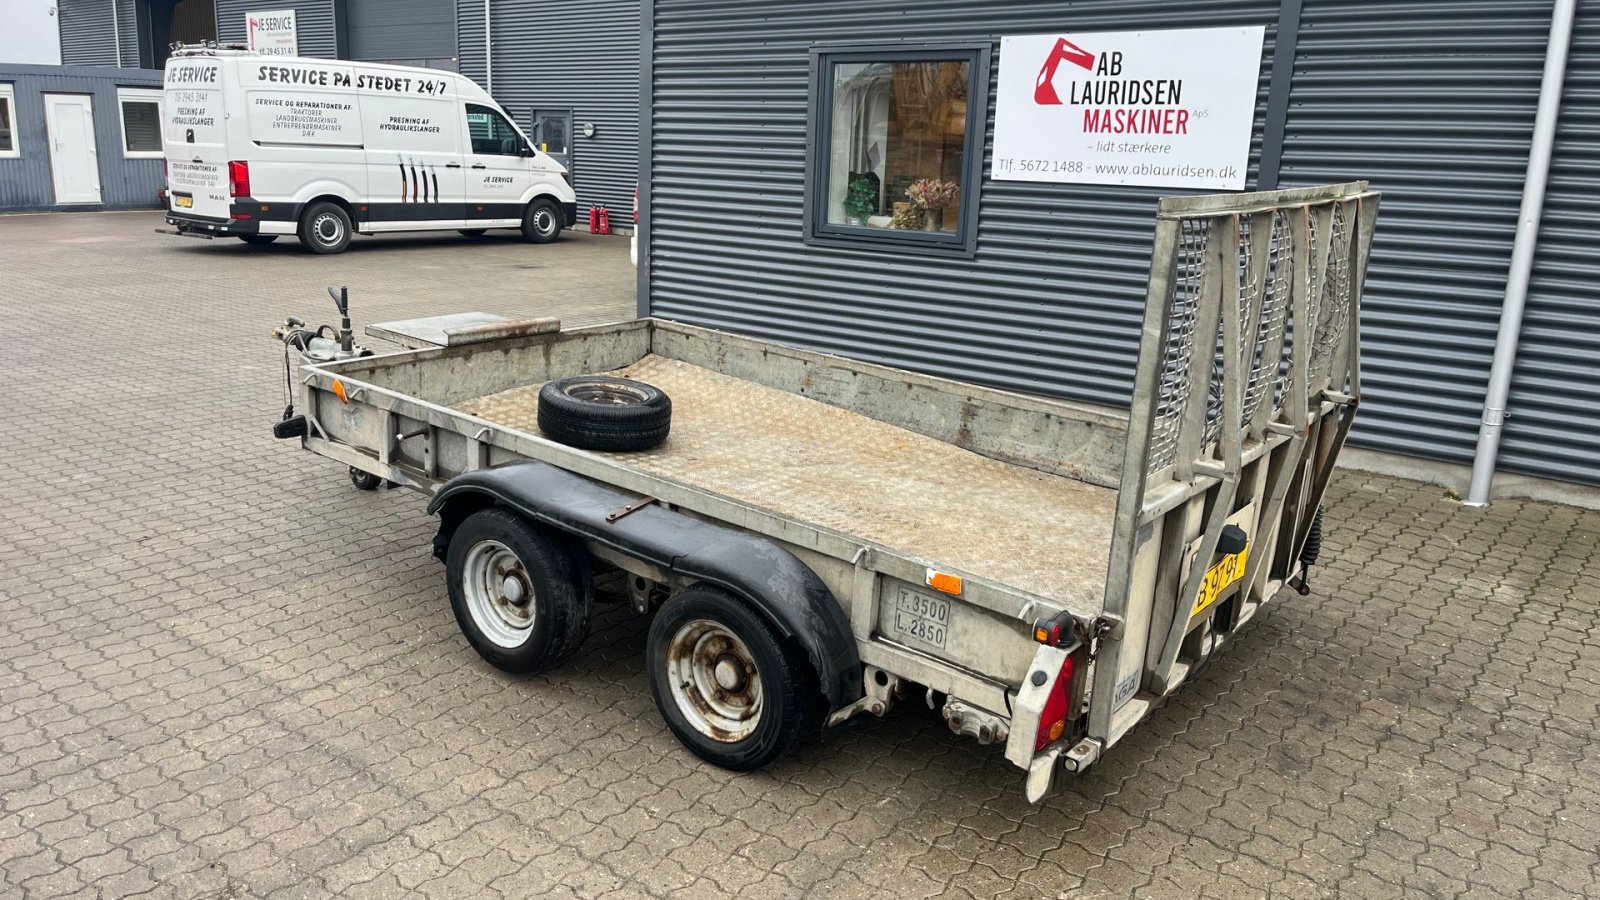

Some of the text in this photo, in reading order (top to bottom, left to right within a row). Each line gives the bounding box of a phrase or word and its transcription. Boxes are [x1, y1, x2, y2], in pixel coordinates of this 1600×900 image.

[258, 16, 292, 31] JE SERVICE
[274, 47, 280, 55] 45
[1096, 51, 1123, 77] AB
[168, 66, 218, 83] JE SERVICE
[258, 66, 446, 96] SERVICE PÅ STEDET 24/7
[1070, 79, 1182, 105] LAURIDSEN
[255, 98, 283, 106] SERVICE
[296, 101, 343, 110] REPARATIONER
[275, 114, 338, 124] LANDBRUGSMASKINER
[290, 108, 323, 116] TRAKTORER
[389, 116, 421, 125] PRESNING
[1083, 109, 1209, 135] MASKINER ApS
[380, 123, 440, 133] HYDRAULIKSLANGER
[1096, 141, 1115, 153] lidt
[1117, 141, 1171, 155] stærkere
[999, 158, 1017, 174] Tlf.
[1019, 159, 1049, 172] 5672
[1053, 160, 1084, 173] 1488
[1094, 163, 1238, 180] www.ablauridsen.dk
[492, 176, 514, 184] SERVICE
